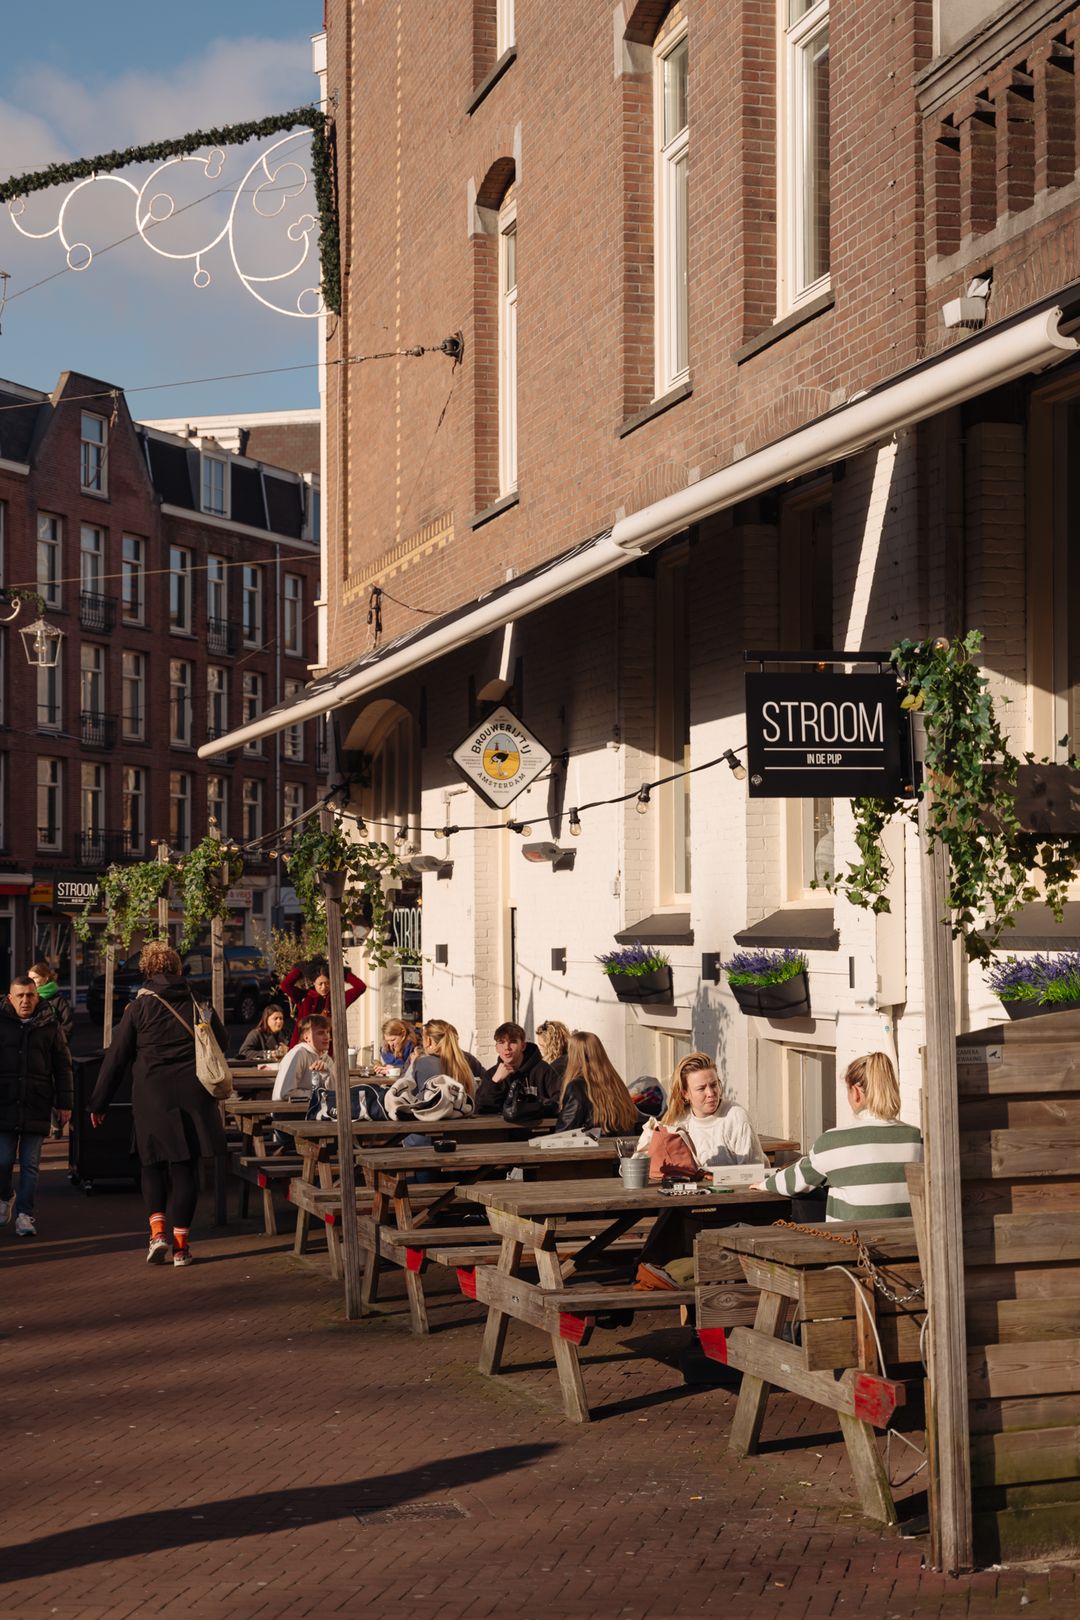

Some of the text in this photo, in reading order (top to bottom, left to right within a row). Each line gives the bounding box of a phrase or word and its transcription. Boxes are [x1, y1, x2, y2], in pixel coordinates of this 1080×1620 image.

[762, 701, 884, 743] STROOM
[807, 753, 815, 765] IN
[816, 753, 826, 765] DE
[477, 772, 526, 789] AMSTERDAM
[57, 882, 98, 897] STROOM
